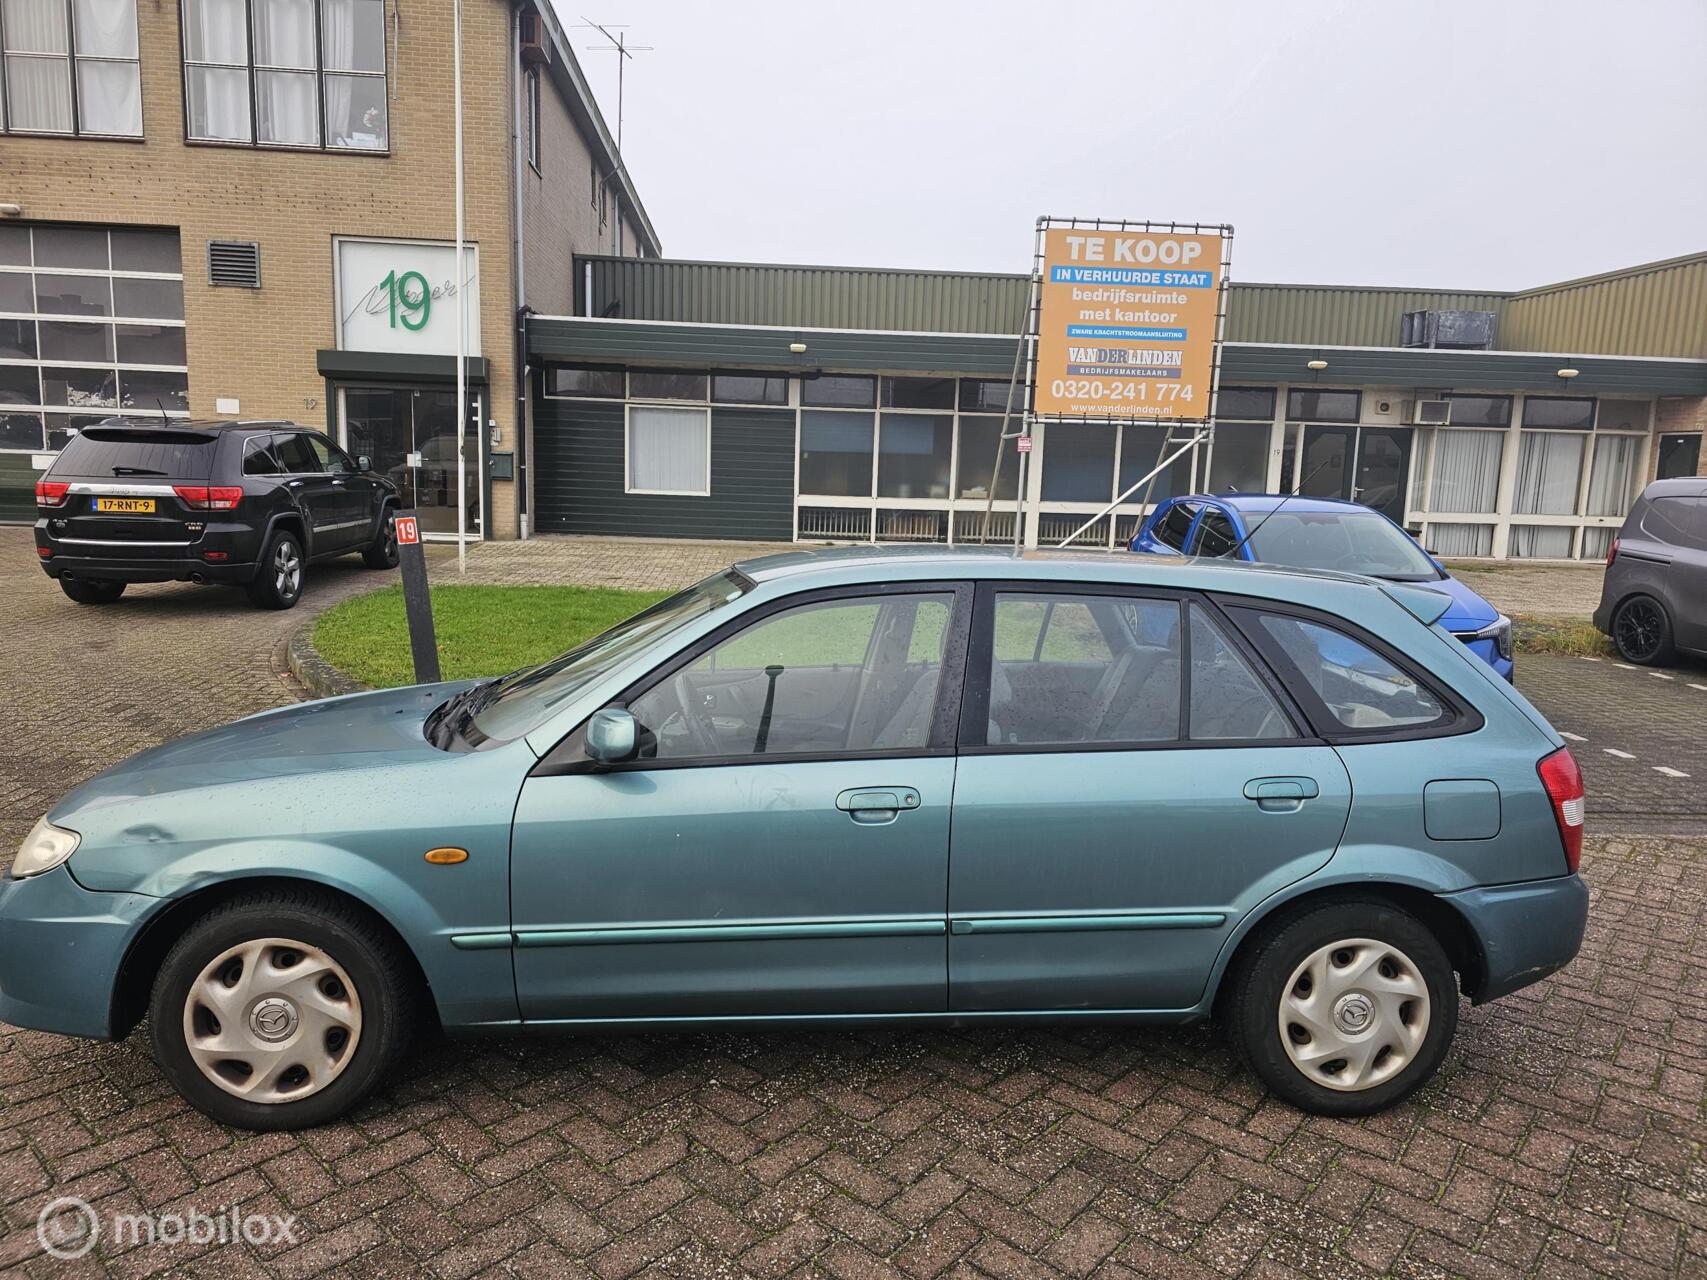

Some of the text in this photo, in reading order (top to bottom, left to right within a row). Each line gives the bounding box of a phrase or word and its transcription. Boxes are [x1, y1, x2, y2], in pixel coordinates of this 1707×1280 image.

[1066, 236, 1202, 264] TE KOOP
[1056, 268, 1207, 285] IN VERHUURDE STAAT
[379, 270, 431, 331] 19
[1072, 287, 1188, 305] bedrijfsruimte
[1080, 308, 1178, 323] met kantoor
[1071, 328, 1183, 338] ZWARE KRACHTSTROOMAANSLUITING
[1069, 347, 1183, 366] VANDERLINDEN
[1080, 367, 1168, 376] BEDRIJFSMAKELAARS
[1052, 379, 1193, 402] 0320-241 774
[1071, 403, 1173, 415] www.vanderlinden.nl
[103, 500, 150, 511] 17-RNT-9
[399, 521, 415, 540] 19
